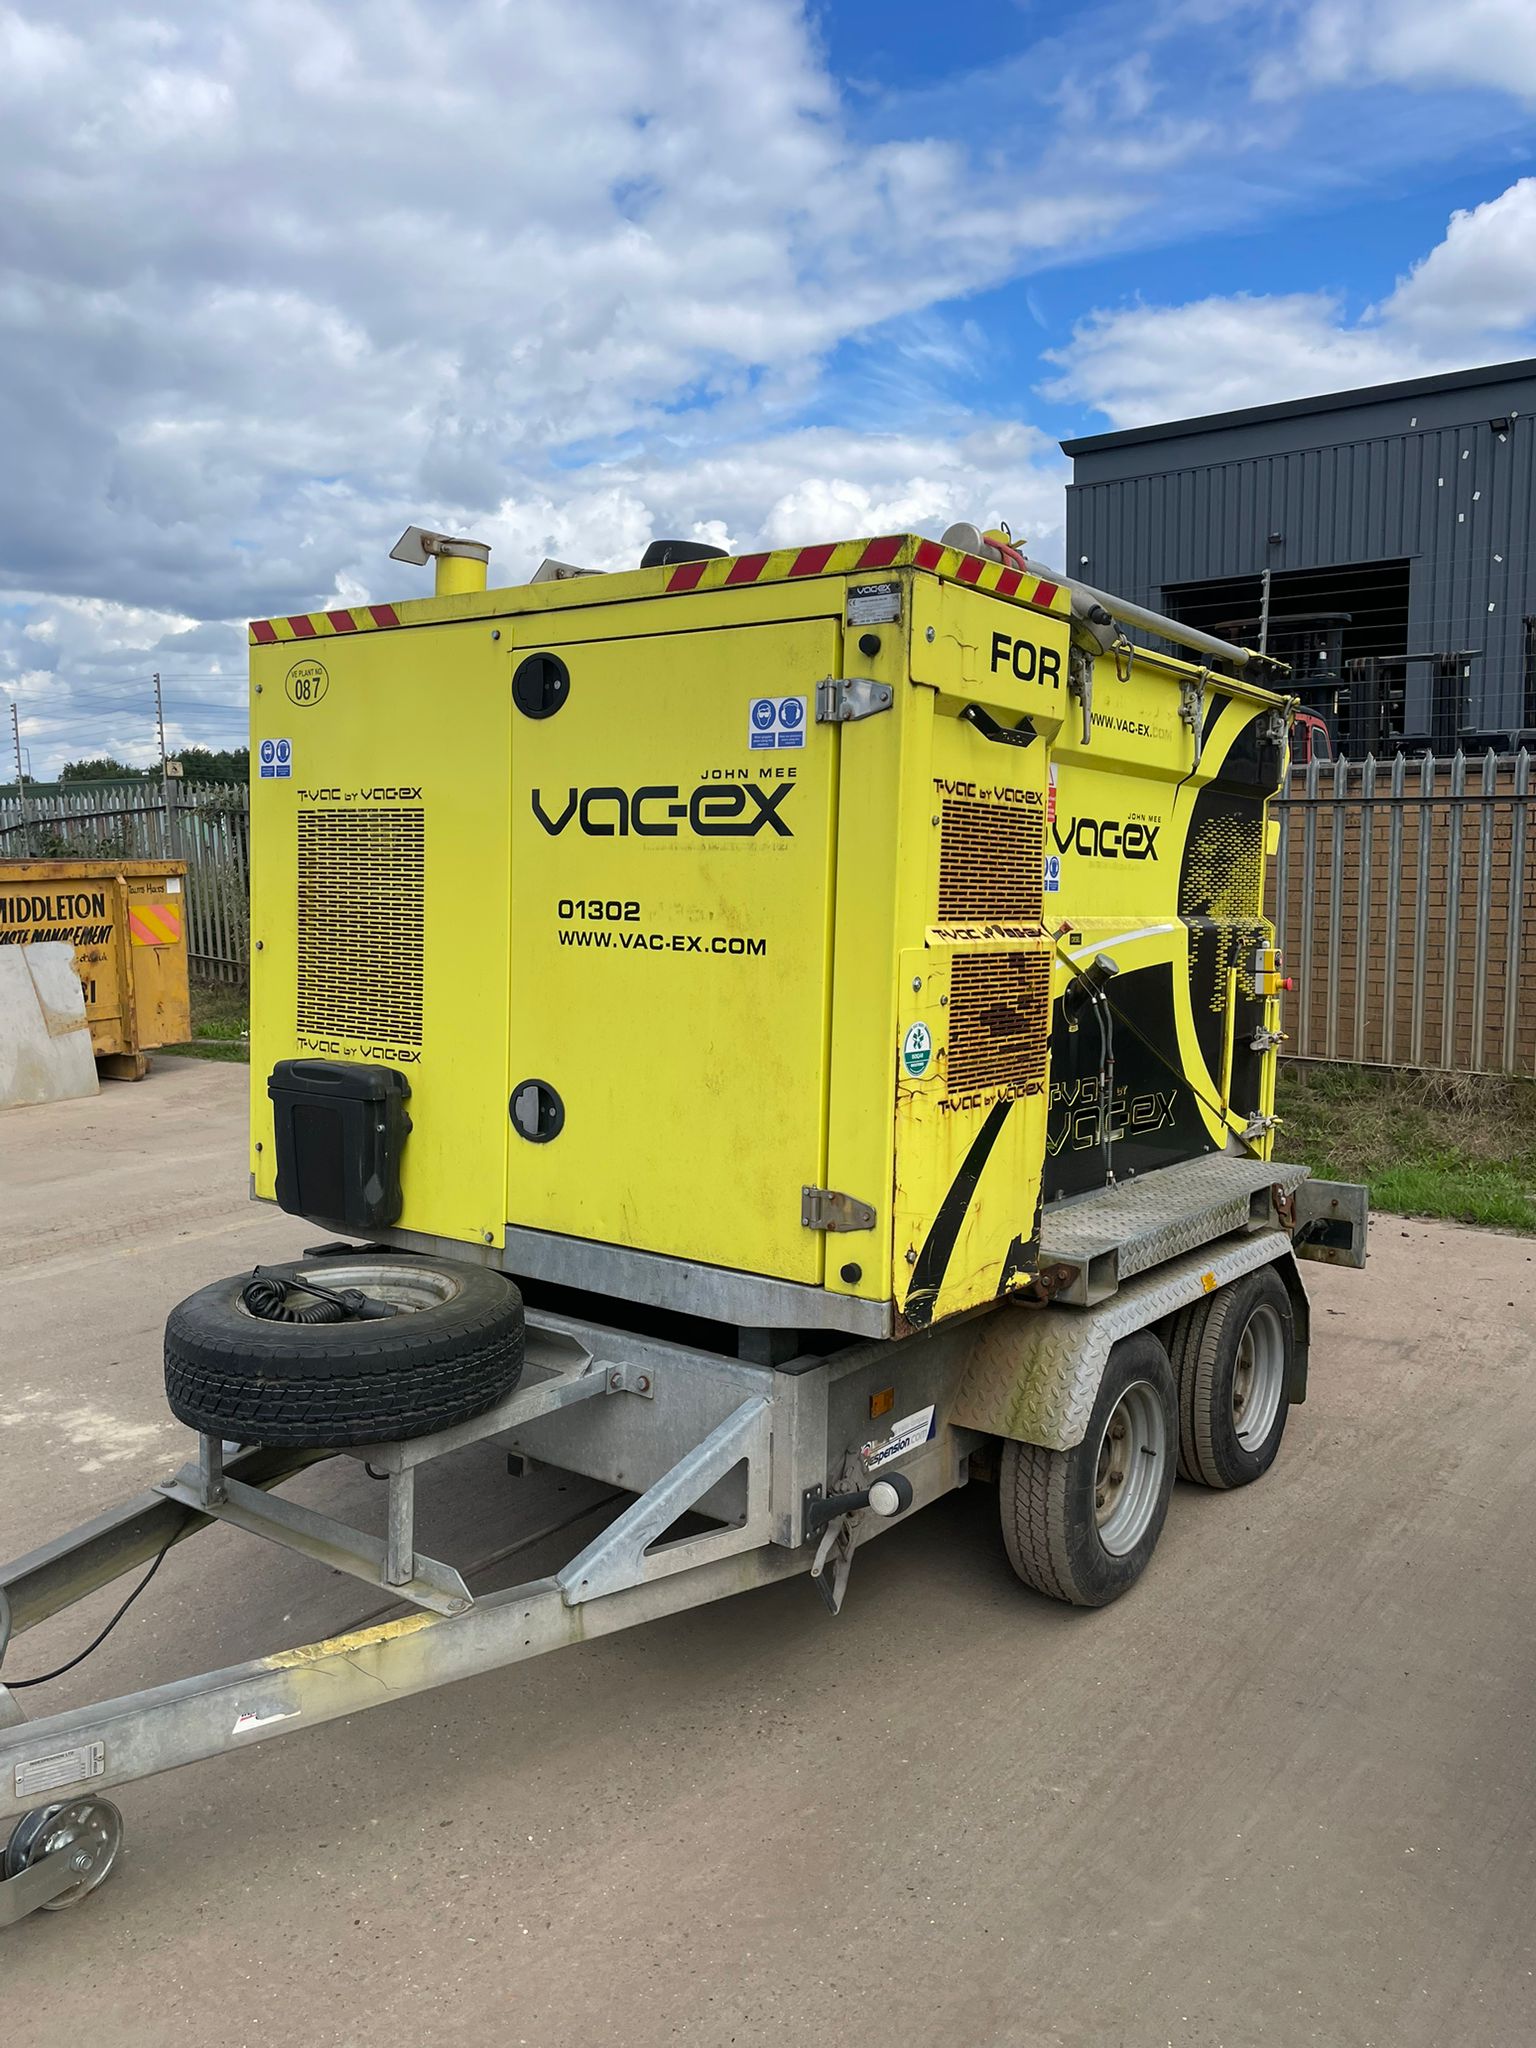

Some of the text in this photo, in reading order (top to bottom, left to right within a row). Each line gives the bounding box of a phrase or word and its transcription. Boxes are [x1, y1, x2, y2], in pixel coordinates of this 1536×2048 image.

[991, 632, 1061, 689] FOR
[295, 677, 320, 701] 087
[701, 767, 797, 779] JOHN MEE
[1128, 813, 1161, 823] JOHN MEE
[558, 900, 641, 922] 01302
[558, 930, 767, 956] WWW.VAC-EX.COM
